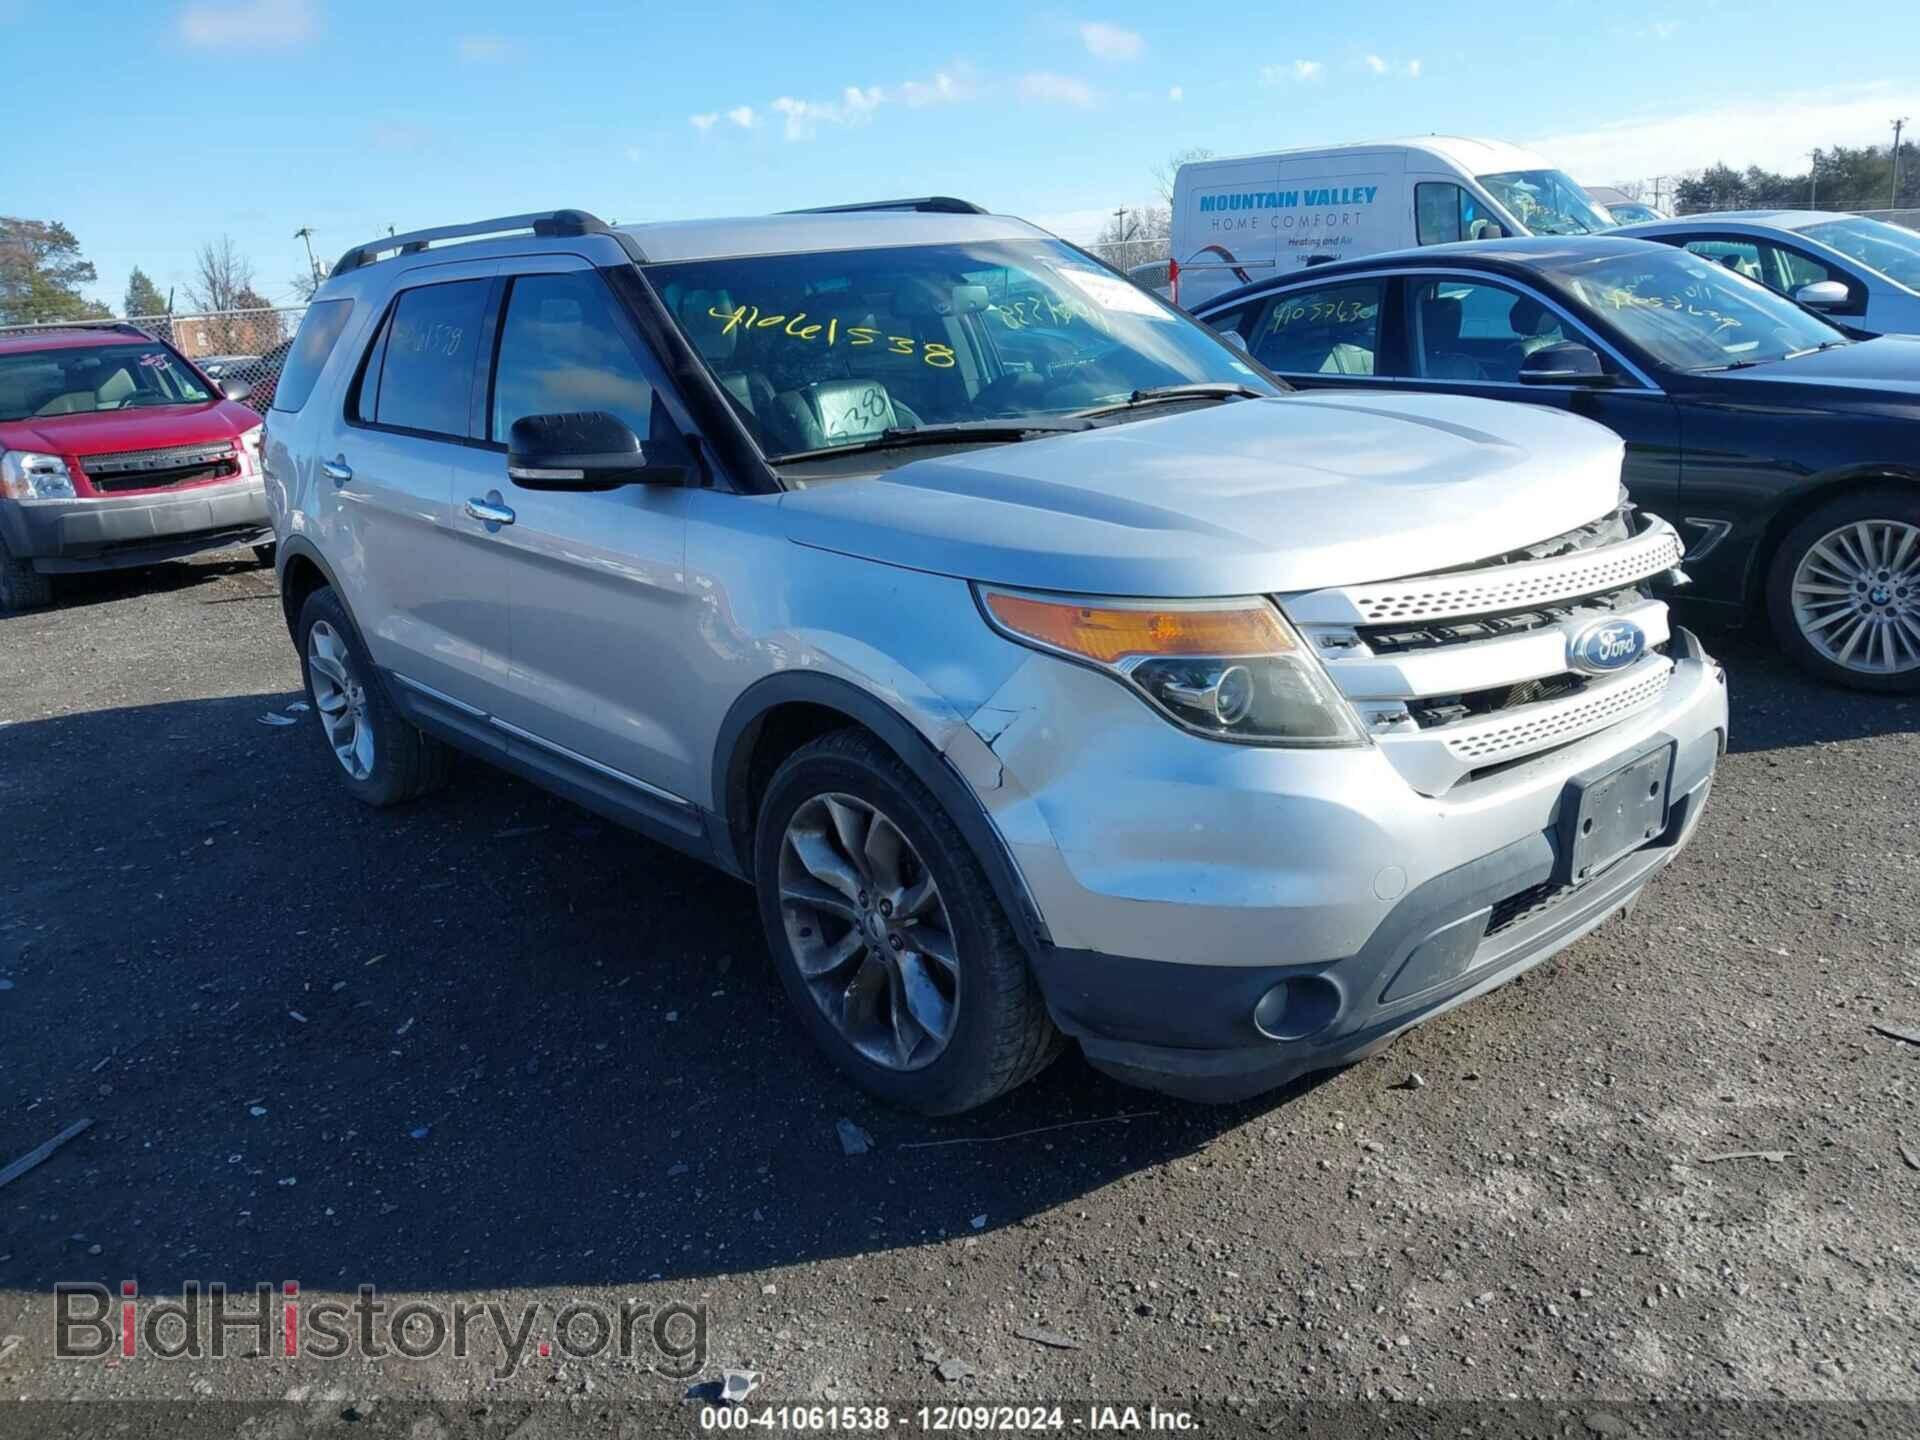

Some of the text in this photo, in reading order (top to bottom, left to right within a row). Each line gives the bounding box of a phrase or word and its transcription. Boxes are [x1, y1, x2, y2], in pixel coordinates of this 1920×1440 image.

[1200, 186, 1378, 212] MOUNTAIN VALLEY
[1212, 212, 1361, 231] HOME COMFORT
[1288, 236, 1321, 248] Heating
[1322, 236, 1340, 246] and
[708, 306, 956, 368] 41061538
[1599, 627, 1636, 661] Ford
